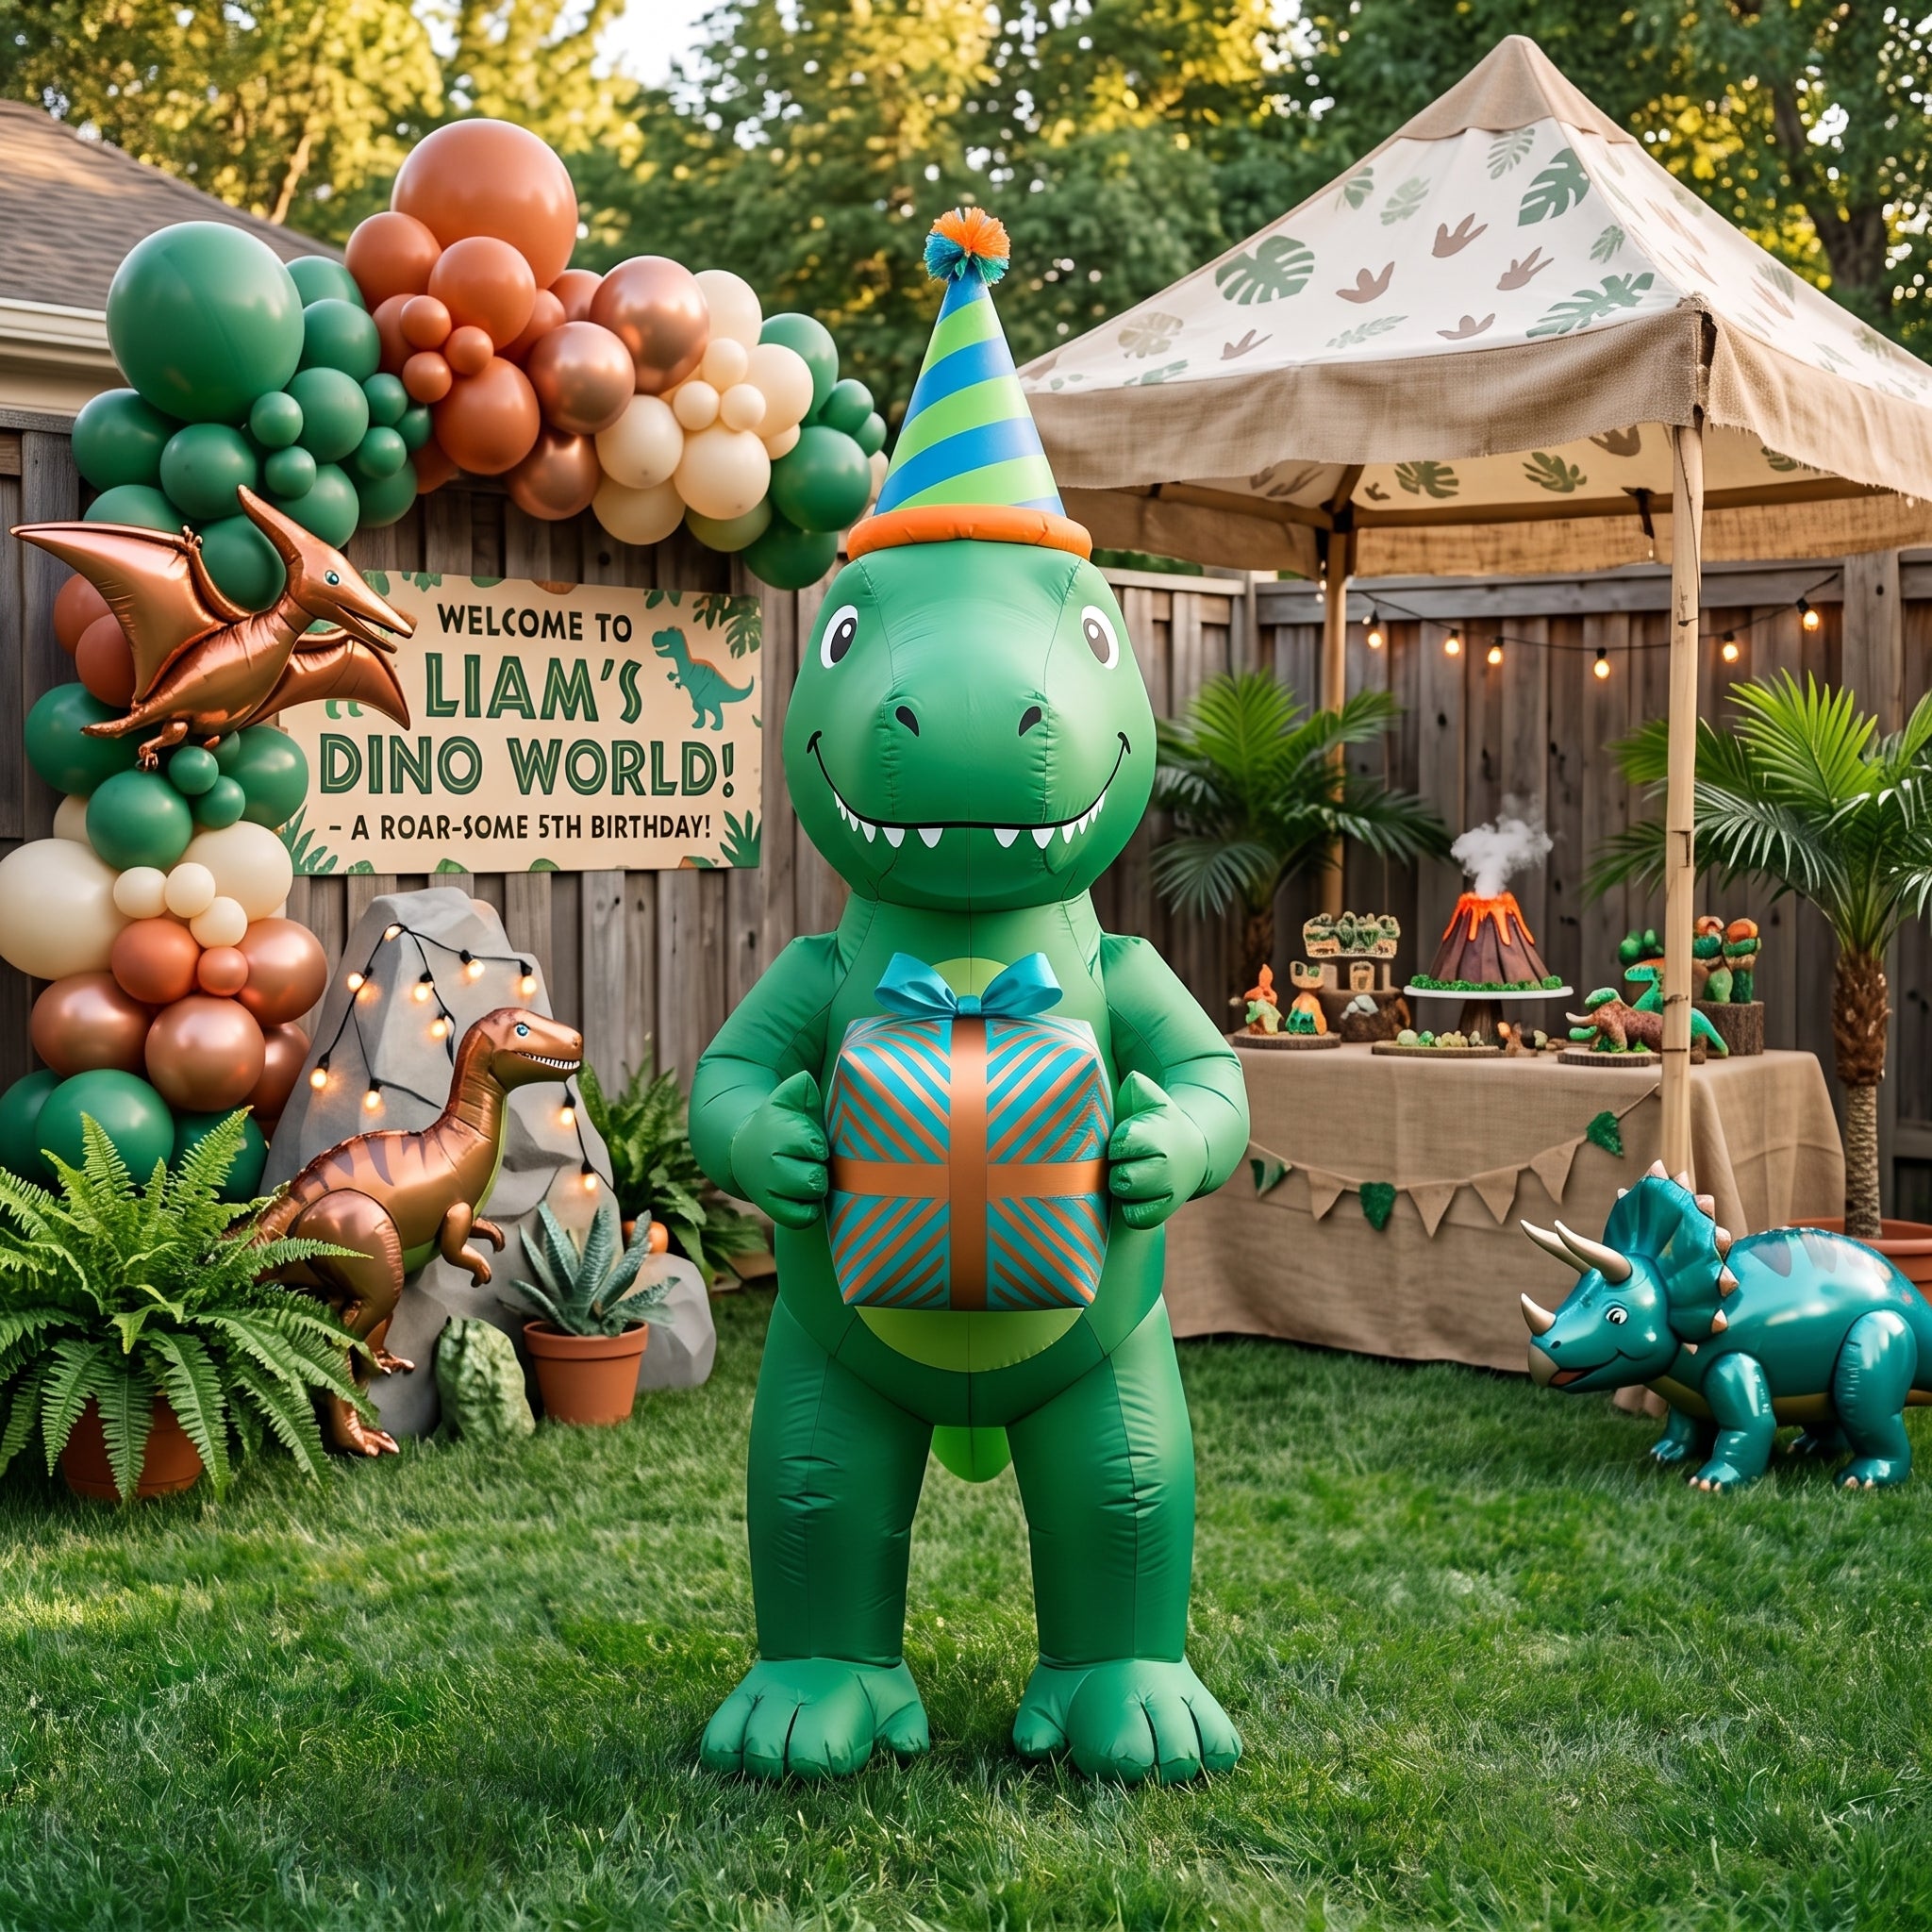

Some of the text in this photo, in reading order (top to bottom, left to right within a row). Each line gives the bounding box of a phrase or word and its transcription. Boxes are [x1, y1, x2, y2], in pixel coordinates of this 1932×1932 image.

[437, 603, 633, 643] WELCOME TO
[425, 652, 643, 724] LIAM'S
[320, 733, 735, 799] DINO WORLD!
[351, 814, 370, 841] A
[381, 814, 528, 841] ROAR-SOME
[539, 814, 582, 840] 5TH
[591, 814, 711, 840] BIRTHDAY!
